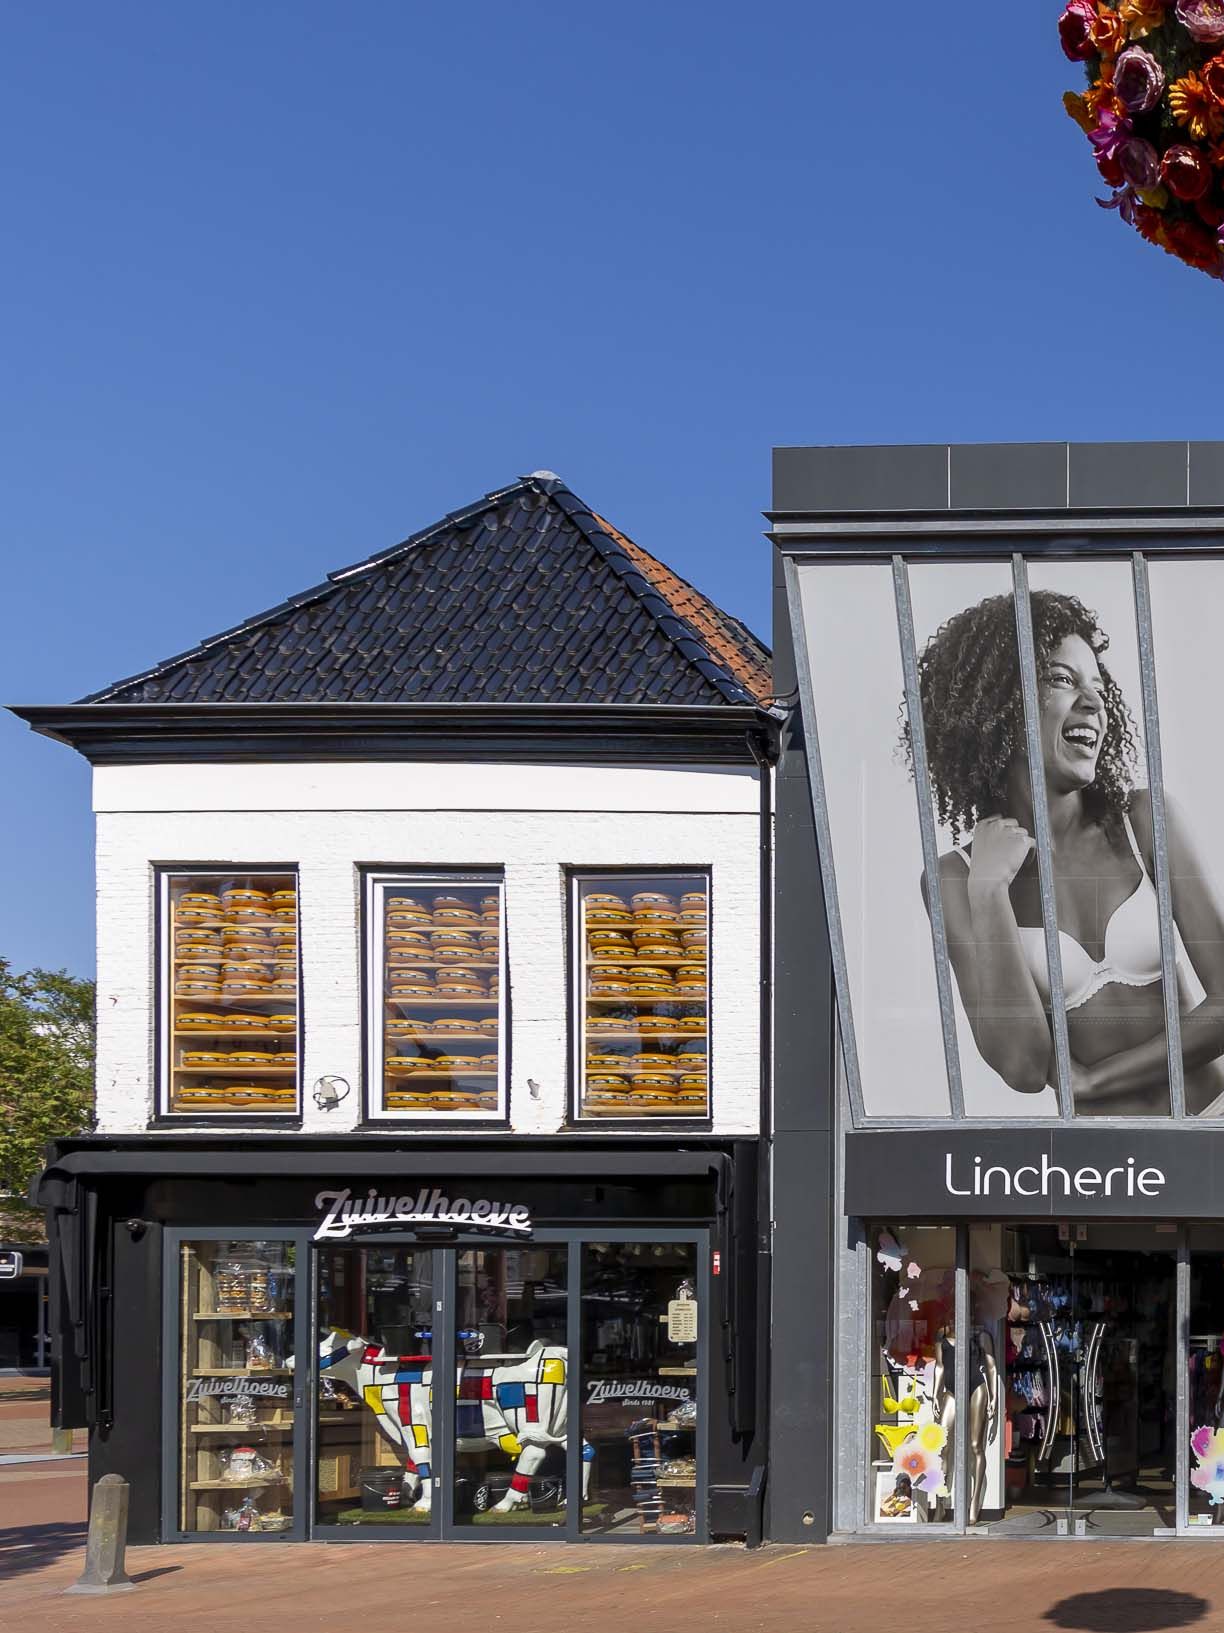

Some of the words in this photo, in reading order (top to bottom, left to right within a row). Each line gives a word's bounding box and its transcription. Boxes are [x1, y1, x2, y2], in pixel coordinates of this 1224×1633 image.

[945, 1153, 1165, 1196] Lincherie
[313, 1188, 532, 1240] Zuivelhoeve
[186, 1379, 288, 1402] Zuivelhoeve
[586, 1380, 690, 1405] Zuivelhoeve
